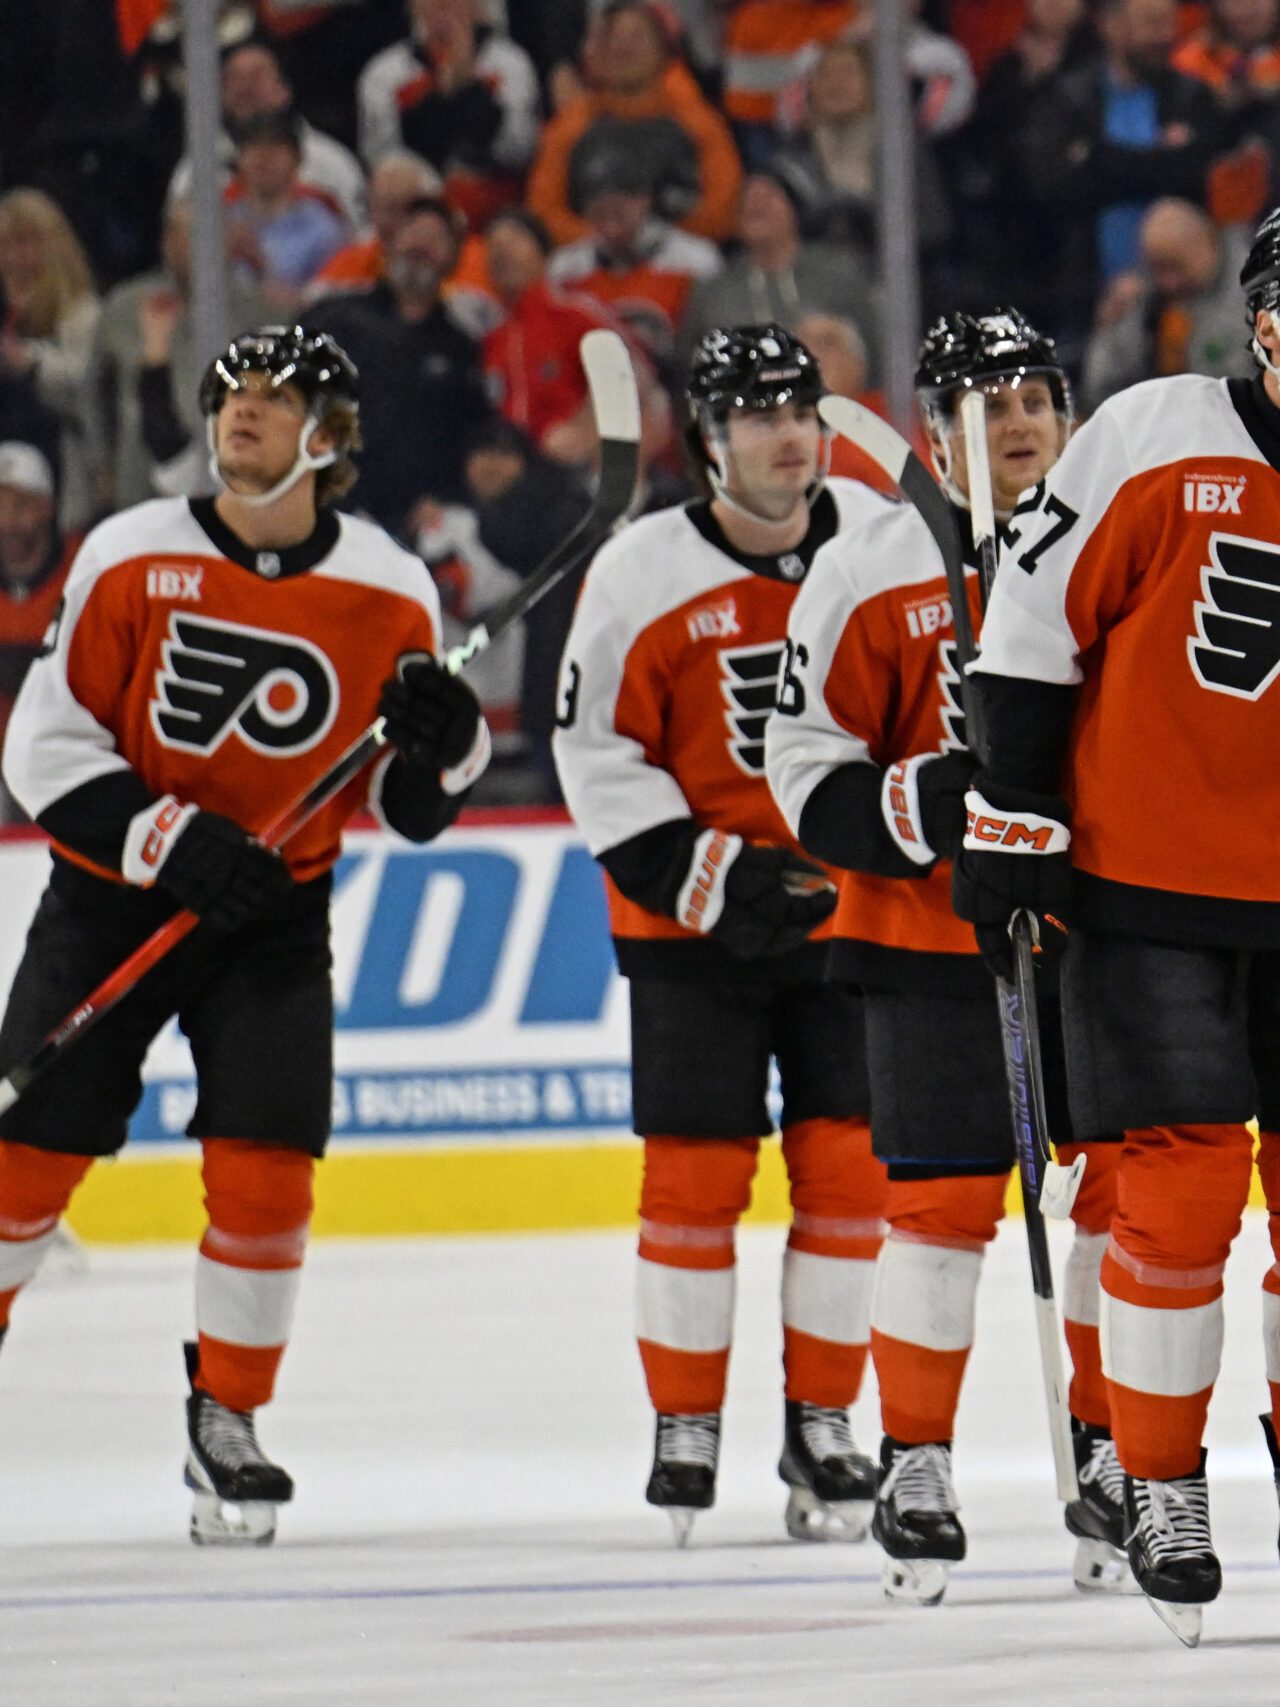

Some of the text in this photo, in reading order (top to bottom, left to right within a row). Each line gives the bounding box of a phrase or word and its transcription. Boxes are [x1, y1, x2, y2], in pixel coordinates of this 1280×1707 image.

[1184, 481, 1245, 515] IBX
[147, 568, 203, 602] IBX
[686, 600, 741, 642] IBX
[333, 846, 615, 1030] DI
[355, 1073, 539, 1127] BUSINESS
